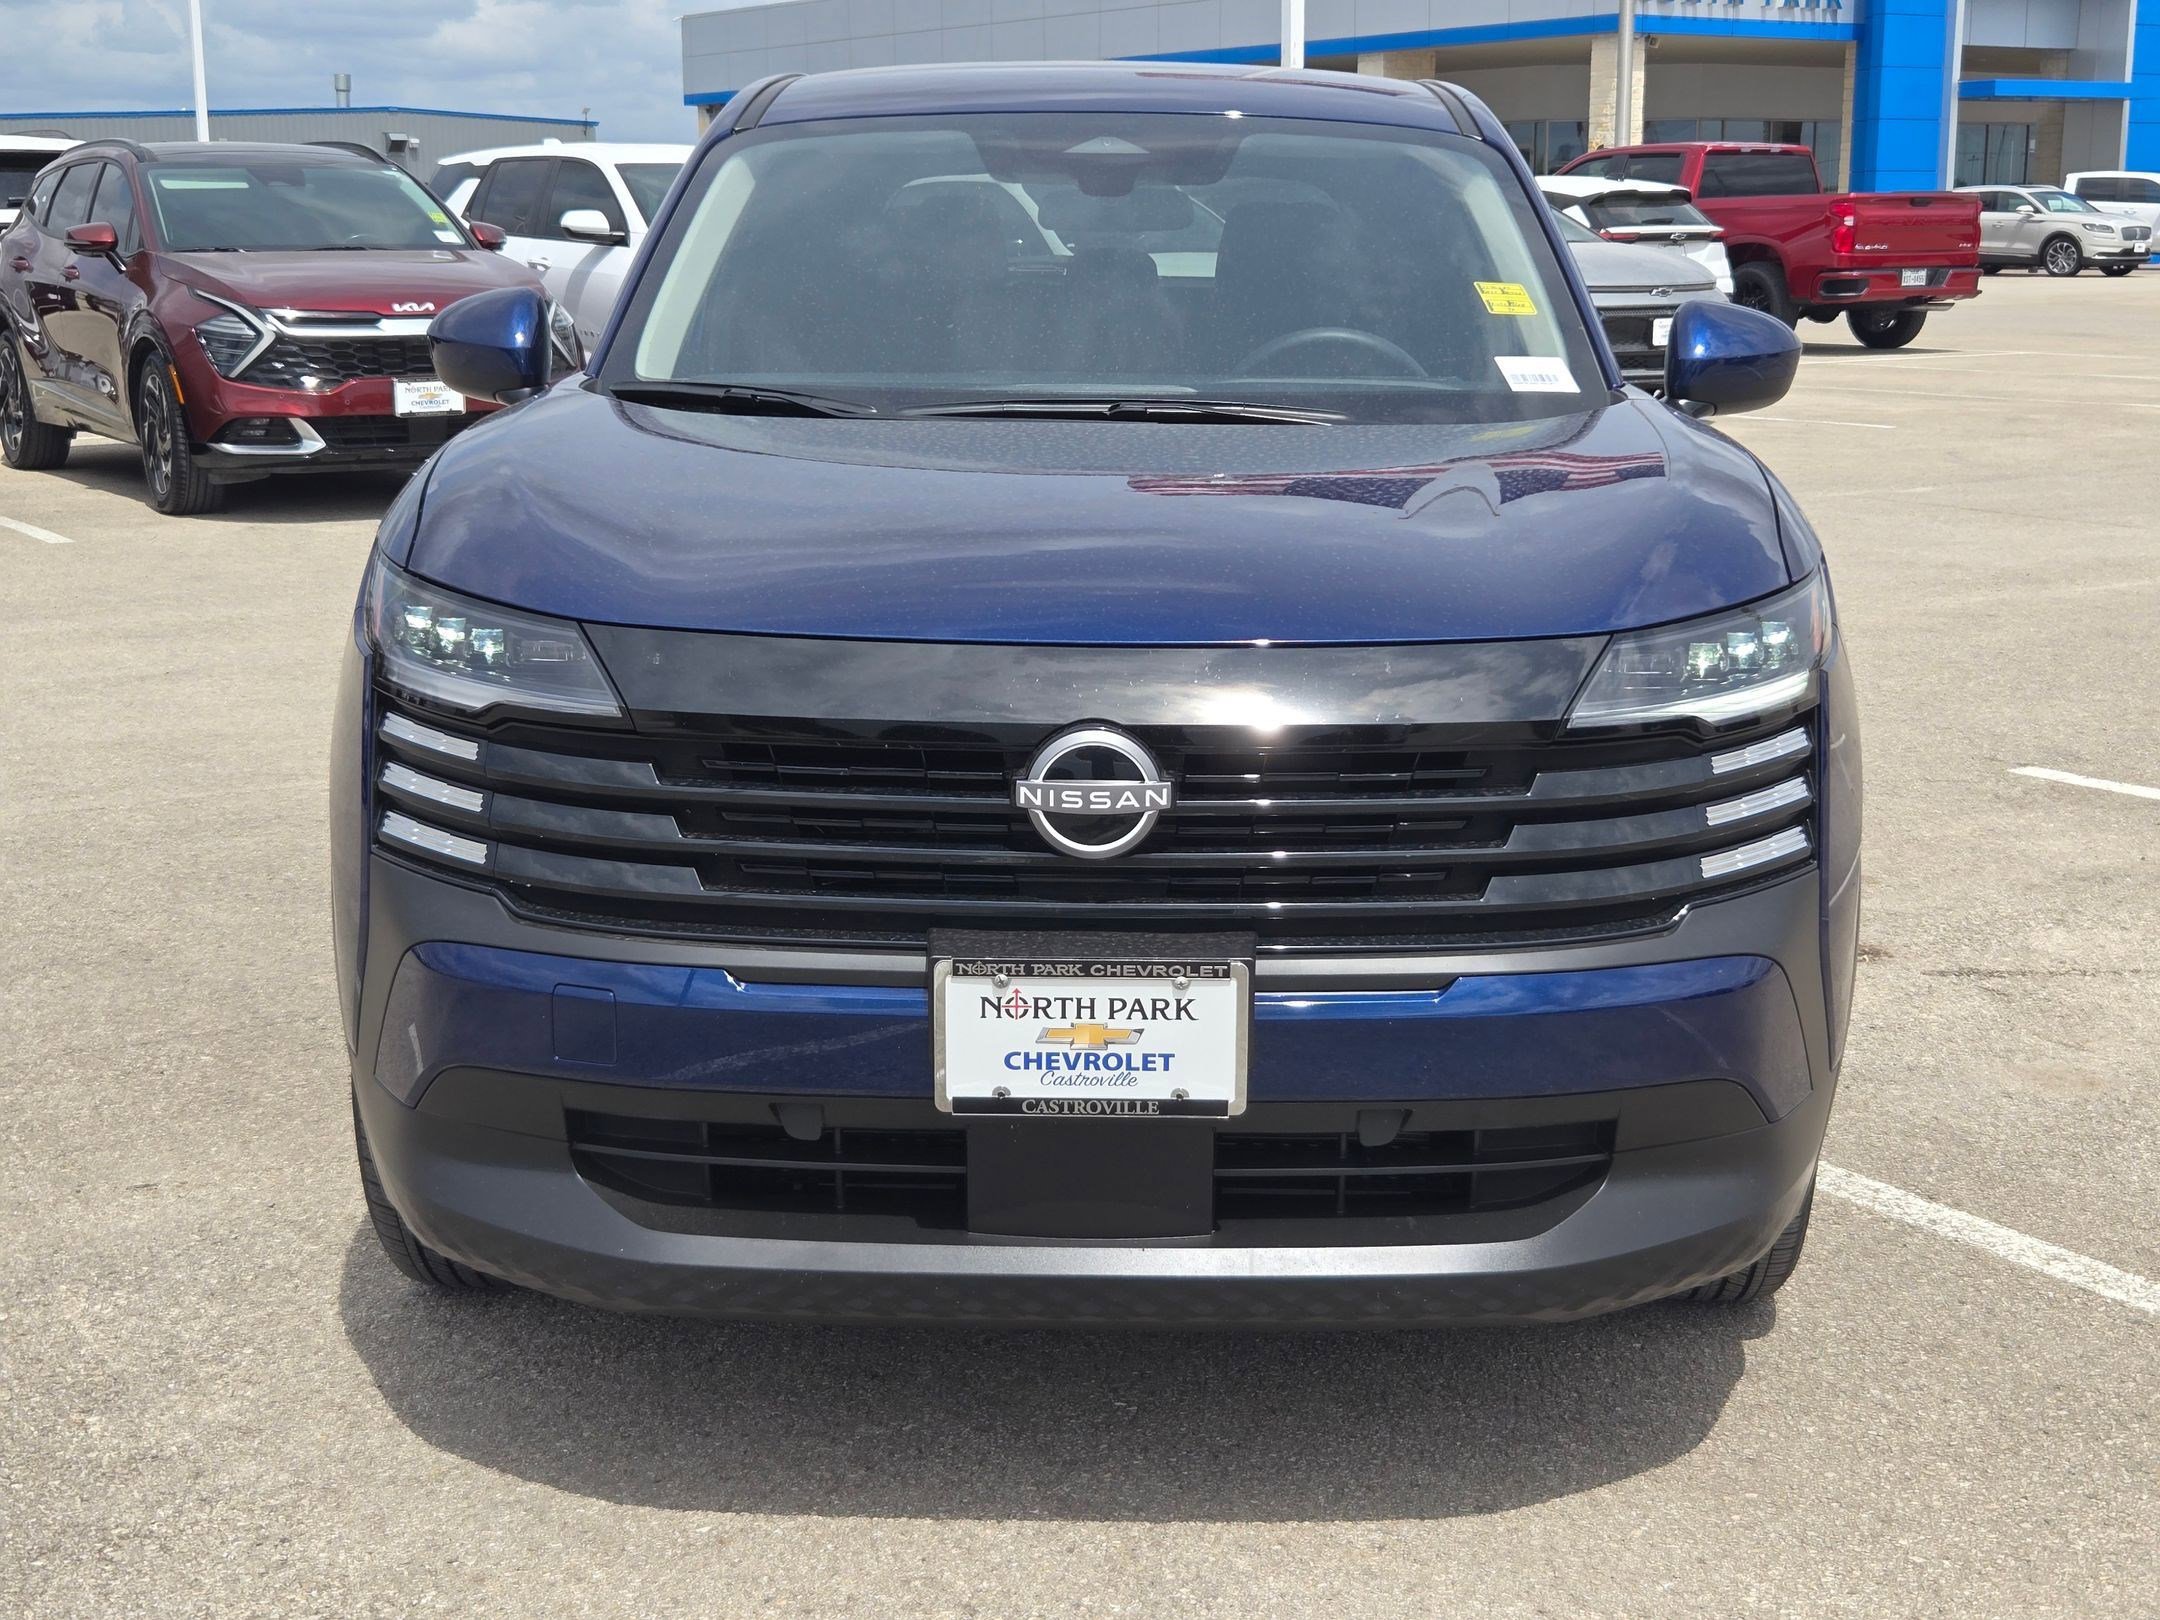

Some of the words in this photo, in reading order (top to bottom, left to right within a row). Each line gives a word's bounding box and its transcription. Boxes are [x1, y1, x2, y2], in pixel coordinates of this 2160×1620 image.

[405, 385, 432, 393] NORTH
[1019, 786, 1168, 809] NISSAN
[956, 961, 1025, 976] NORTH
[1032, 963, 1085, 977] PARK
[1090, 965, 1228, 978] CHEVROLET
[980, 989, 1096, 1020] NORTH
[1108, 998, 1199, 1021] PARK
[1003, 1051, 1175, 1071] CHEVROLET
[1040, 1070, 1139, 1088] Castroville
[1021, 1099, 1160, 1115] CASTROVILLE
